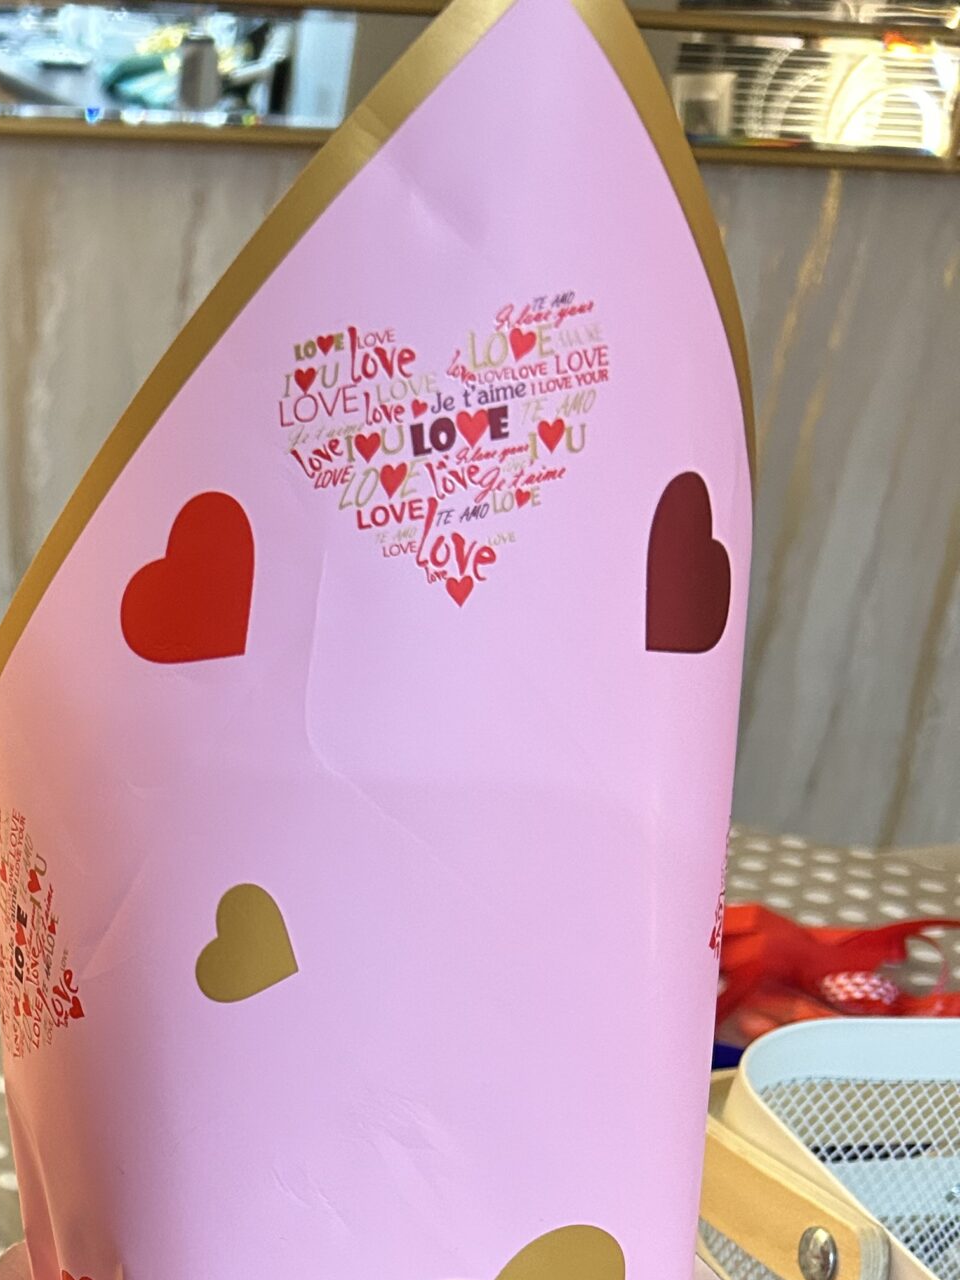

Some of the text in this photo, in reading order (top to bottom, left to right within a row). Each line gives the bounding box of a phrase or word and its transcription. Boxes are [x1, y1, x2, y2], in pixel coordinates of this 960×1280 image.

[357, 329, 396, 349] LOVE
[554, 344, 609, 375] LOVE
[375, 373, 439, 403] LOVE
[538, 376, 573, 395] LOVE
[575, 368, 609, 388] YOUR
[279, 383, 360, 428] LOVE
[430, 382, 527, 415] Je t'aime
[313, 464, 355, 490] LOVE
[356, 499, 426, 530] LOVE
[436, 502, 491, 527] TE AMO
[382, 540, 418, 558] LOVE
